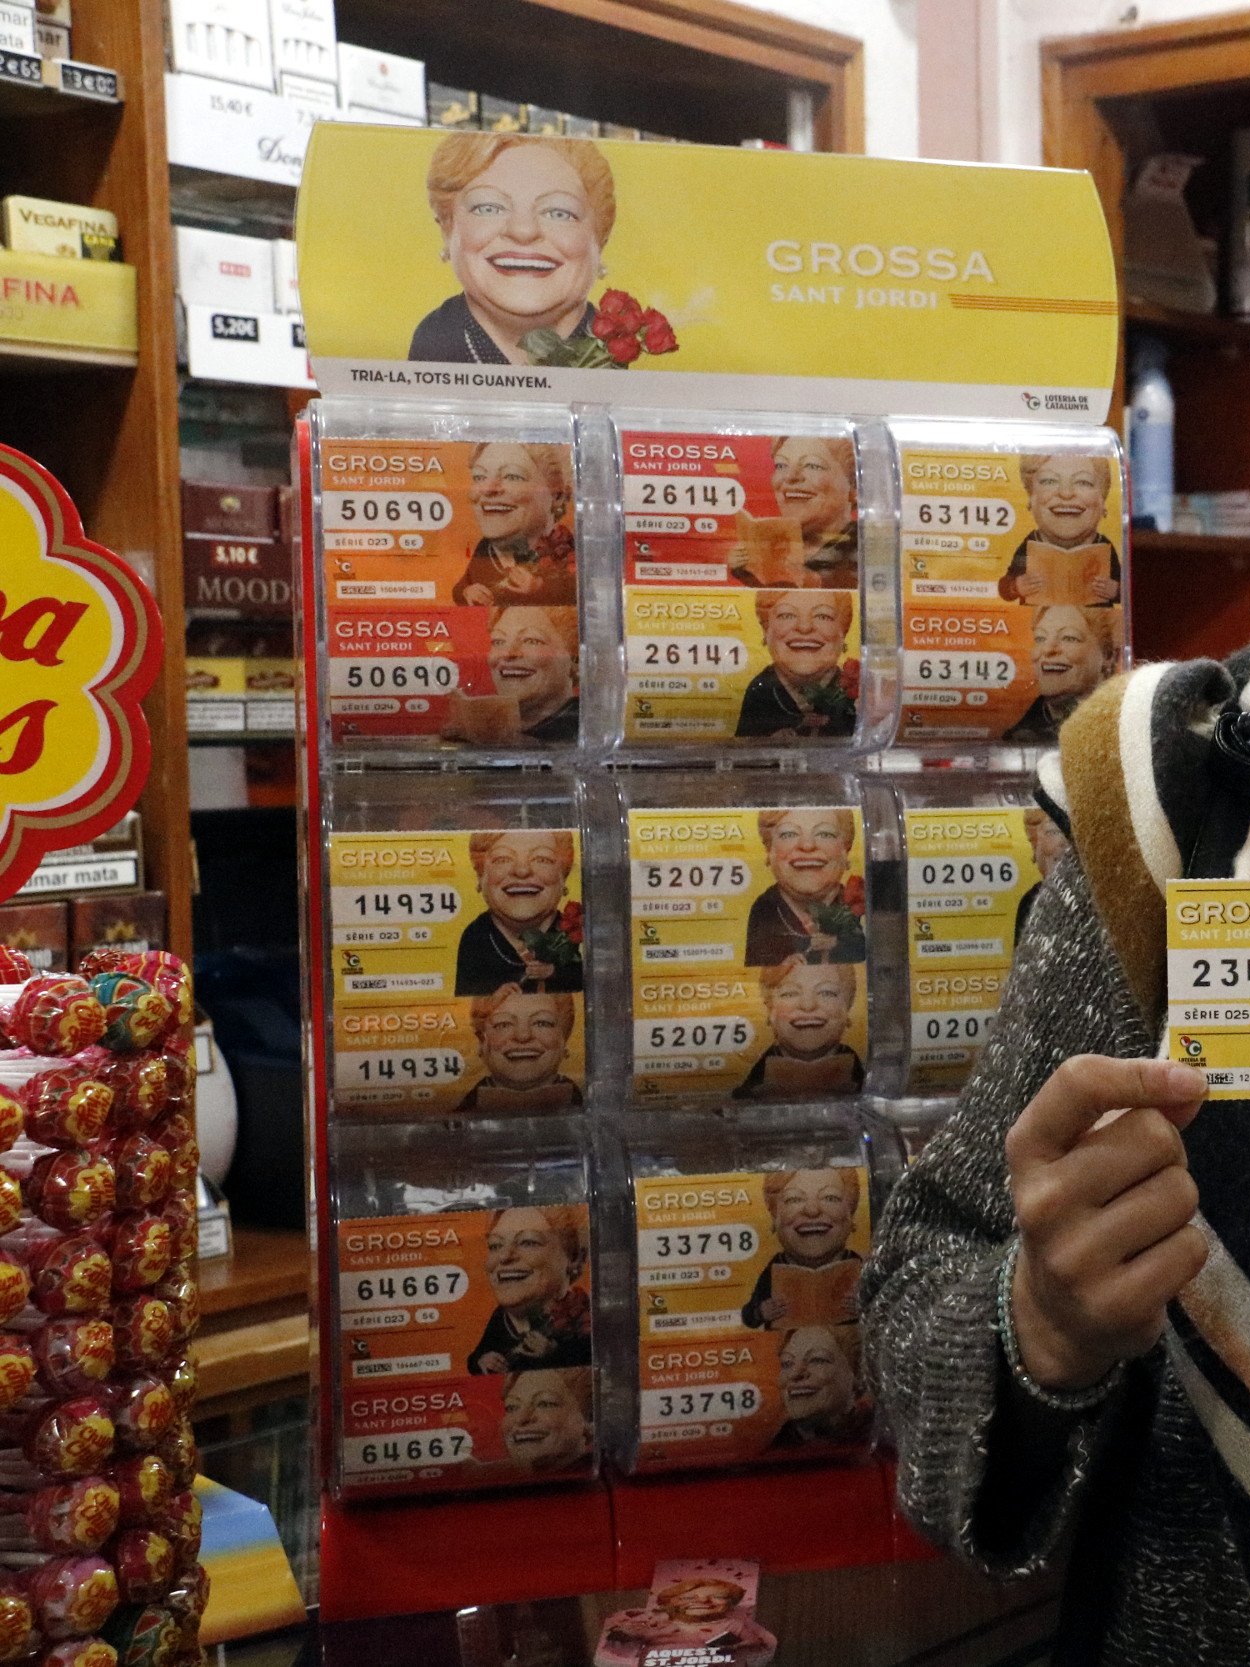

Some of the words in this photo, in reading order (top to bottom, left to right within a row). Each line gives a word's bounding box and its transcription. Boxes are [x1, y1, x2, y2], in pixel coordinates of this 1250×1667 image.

[766, 239, 994, 283] GROSSA
[3, 277, 82, 309] FINA
[771, 284, 845, 304] SANT
[856, 287, 938, 309] JORDI
[350, 369, 411, 384] TRIA-LA,
[414, 372, 451, 385] TOTS
[454, 374, 470, 385] HI
[472, 374, 551, 389] GUANYEM.
[1045, 402, 1089, 411] CATALUNYA
[629, 444, 736, 460] GROSSA
[328, 455, 443, 473] GROSSA
[633, 462, 663, 470] SANT
[667, 463, 702, 472] JORDI
[907, 462, 1009, 482] GROSSA
[332, 476, 364, 485] SANT
[369, 477, 405, 486] JORDI
[911, 482, 940, 491] SANT
[943, 483, 976, 492] JORDI
[642, 483, 737, 508] 26141
[341, 499, 445, 522] 50690
[919, 504, 1009, 528] 63142
[666, 521, 685, 530] 023
[367, 538, 388, 546] 023
[633, 602, 742, 620] GROSSA
[335, 621, 450, 638] GROSSA
[909, 616, 1009, 634] GROSSA
[339, 642, 371, 651] SANT
[375, 642, 413, 652] JORDI
[912, 636, 941, 646] SANT
[944, 637, 976, 647] JORDI
[645, 643, 740, 665] 26141
[347, 665, 451, 688] 50690
[919, 659, 1009, 681] 63142
[638, 824, 744, 842] GROSSA
[910, 823, 1011, 841] GROSSA
[339, 849, 455, 869] GROSSA
[75, 868, 119, 884] mata
[647, 865, 744, 888] 52075
[922, 862, 1013, 884] 02096
[355, 892, 458, 915] 14934
[379, 931, 400, 941] 023
[1180, 929, 1220, 941] SANT
[640, 982, 748, 1001] GROSSA
[916, 976, 1000, 996] GROSS
[342, 1013, 457, 1033] GROSSA
[1184, 1008, 1220, 1020] SÈRIE
[1224, 1010, 1250, 1019] 025
[651, 1024, 747, 1047] 52075
[926, 1017, 994, 1039] 020
[358, 1056, 461, 1081] 14934
[645, 1188, 751, 1211] GROSSA
[346, 1229, 461, 1251] GROSSA
[657, 1231, 753, 1257] 33798
[350, 1254, 383, 1265] SANT
[386, 1253, 423, 1264] JORDI
[357, 1272, 461, 1300] 64667
[648, 1348, 754, 1371] GROSSA
[651, 1374, 680, 1383] SANT
[685, 1371, 720, 1382] JORDI
[351, 1392, 464, 1417] GROSSA
[659, 1389, 755, 1416] 33798
[354, 1420, 386, 1430] SANT
[390, 1417, 427, 1429] JORDI
[362, 1435, 465, 1463] 64667
[644, 1658, 671, 1667] ST.
[645, 1647, 720, 1659] AQUEST
